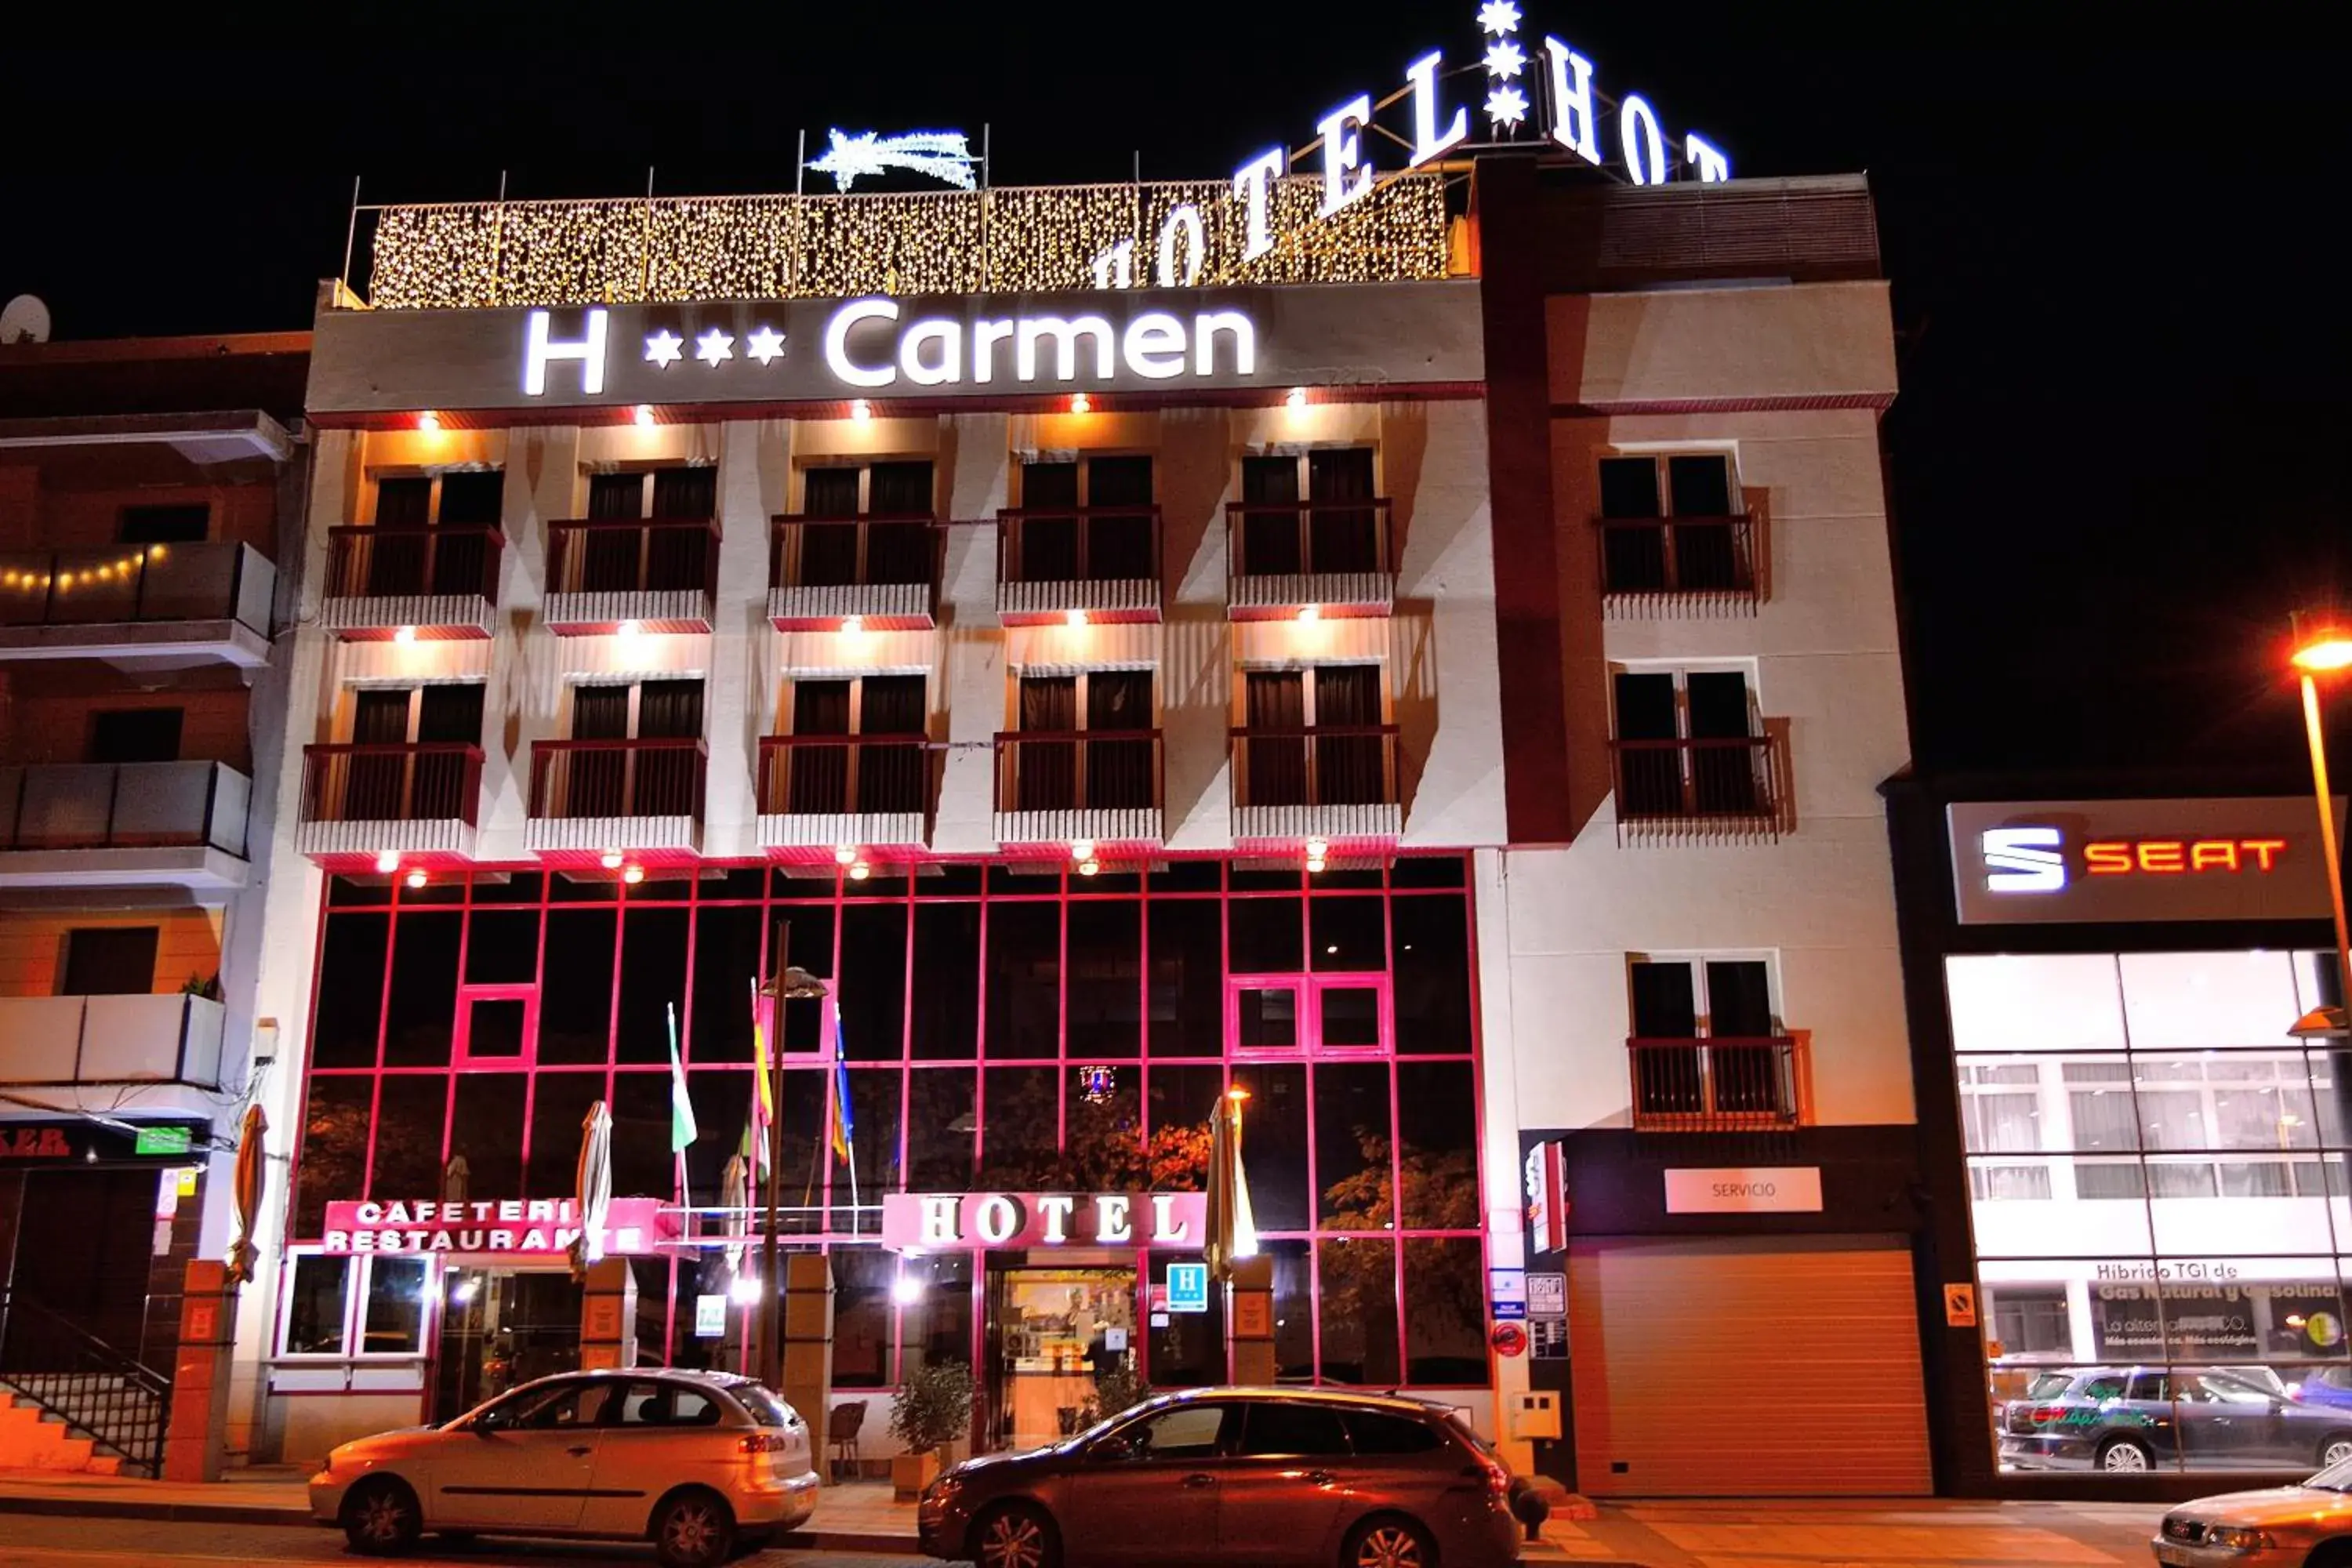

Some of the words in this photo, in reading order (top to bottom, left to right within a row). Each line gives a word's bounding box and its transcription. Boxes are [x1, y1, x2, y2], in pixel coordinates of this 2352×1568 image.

[524, 310, 608, 395] H
[826, 299, 1254, 387] Carmen
[2084, 839, 2285, 875] SEAT
[1712, 1182, 1776, 1198] SERVICIO
[356, 1200, 570, 1225] CAFETERI
[920, 1194, 1189, 1244] HOTEL
[1179, 1269, 1196, 1290] H
[2174, 1262, 2208, 1278] TGI
[2214, 1262, 2238, 1279] de
[2099, 1285, 2140, 1300] Gas
